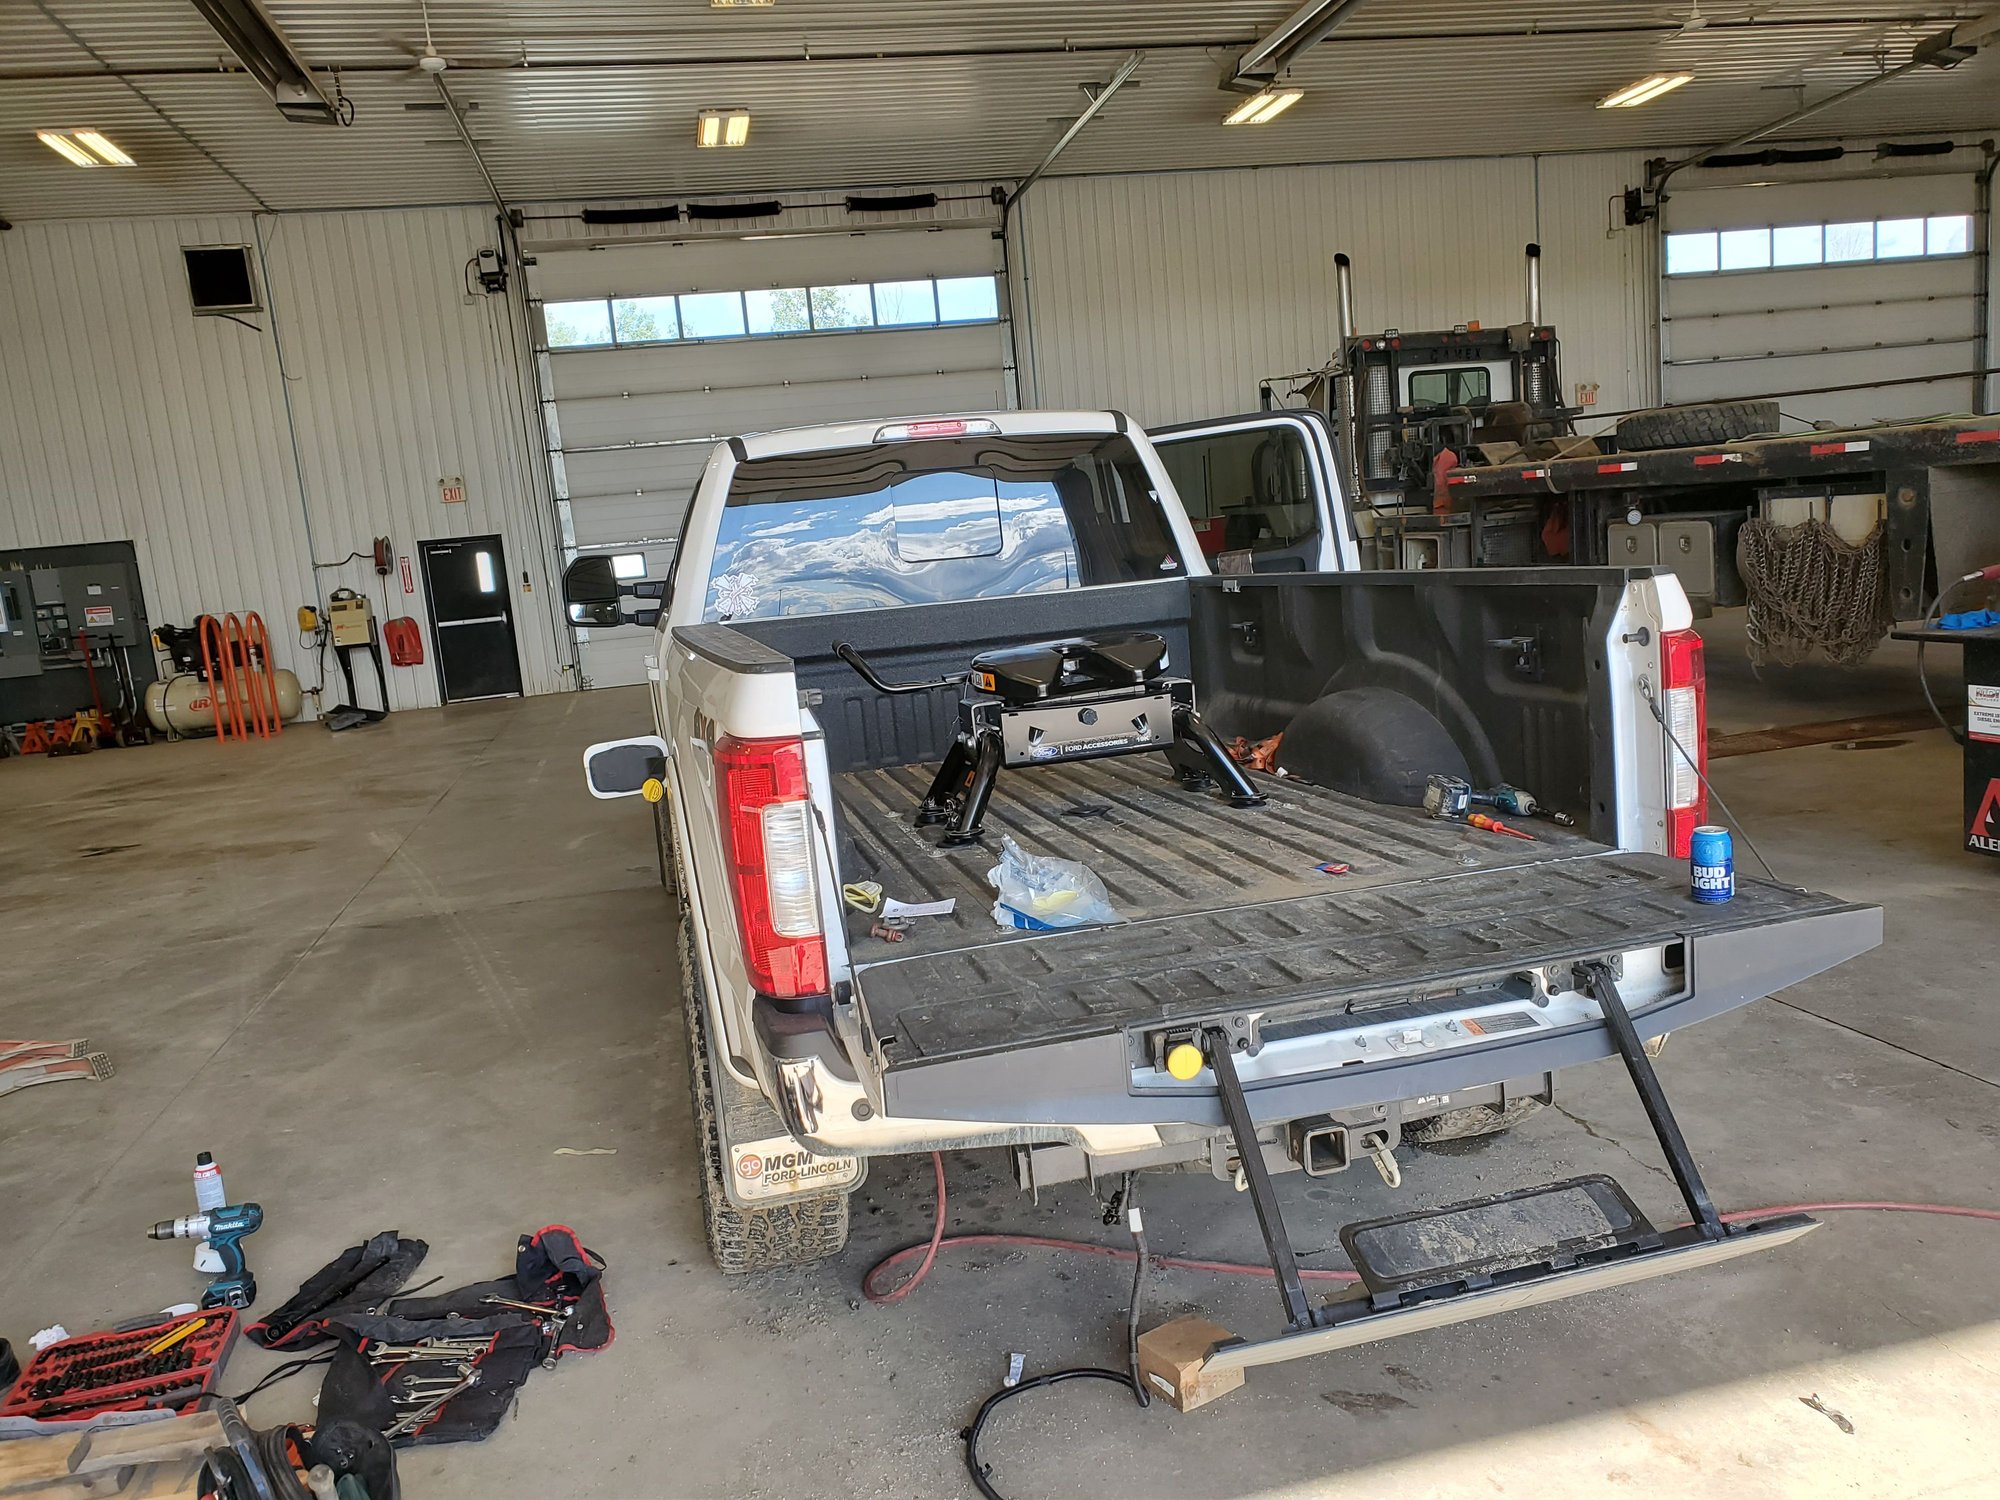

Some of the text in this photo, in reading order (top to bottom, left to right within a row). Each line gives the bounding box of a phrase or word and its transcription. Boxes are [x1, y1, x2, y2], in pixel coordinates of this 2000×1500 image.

[1580, 391, 1595, 403] EXIT
[442, 486, 462, 501] EXIT
[1065, 744, 1083, 752] FORD
[1083, 738, 1129, 750] ACCESSORIES
[1968, 834, 2000, 852] ALE
[1693, 865, 1726, 879] BUD
[1691, 875, 1731, 890] LIGHT
[764, 1151, 814, 1172] MGM
[764, 1159, 851, 1184] FORD-LINCOLN
[214, 1221, 245, 1231] Makita
